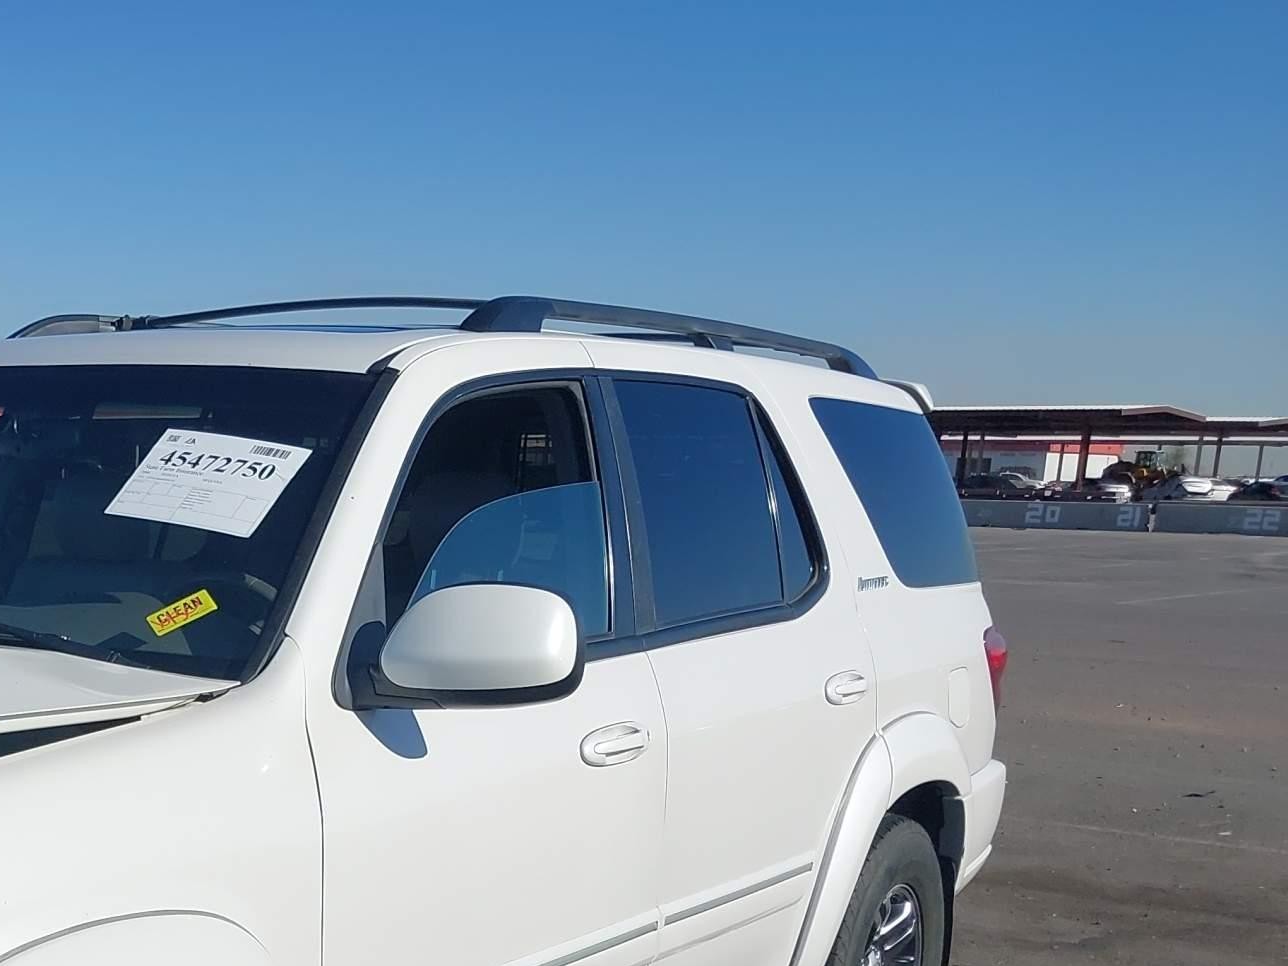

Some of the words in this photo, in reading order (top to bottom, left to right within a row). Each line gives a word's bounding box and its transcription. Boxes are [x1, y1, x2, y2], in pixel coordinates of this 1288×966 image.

[159, 449, 276, 481] 45472750
[1024, 503, 1062, 523] 20
[1116, 506, 1141, 527] 21
[1243, 508, 1281, 530] 22
[157, 596, 203, 624] CLEAN
